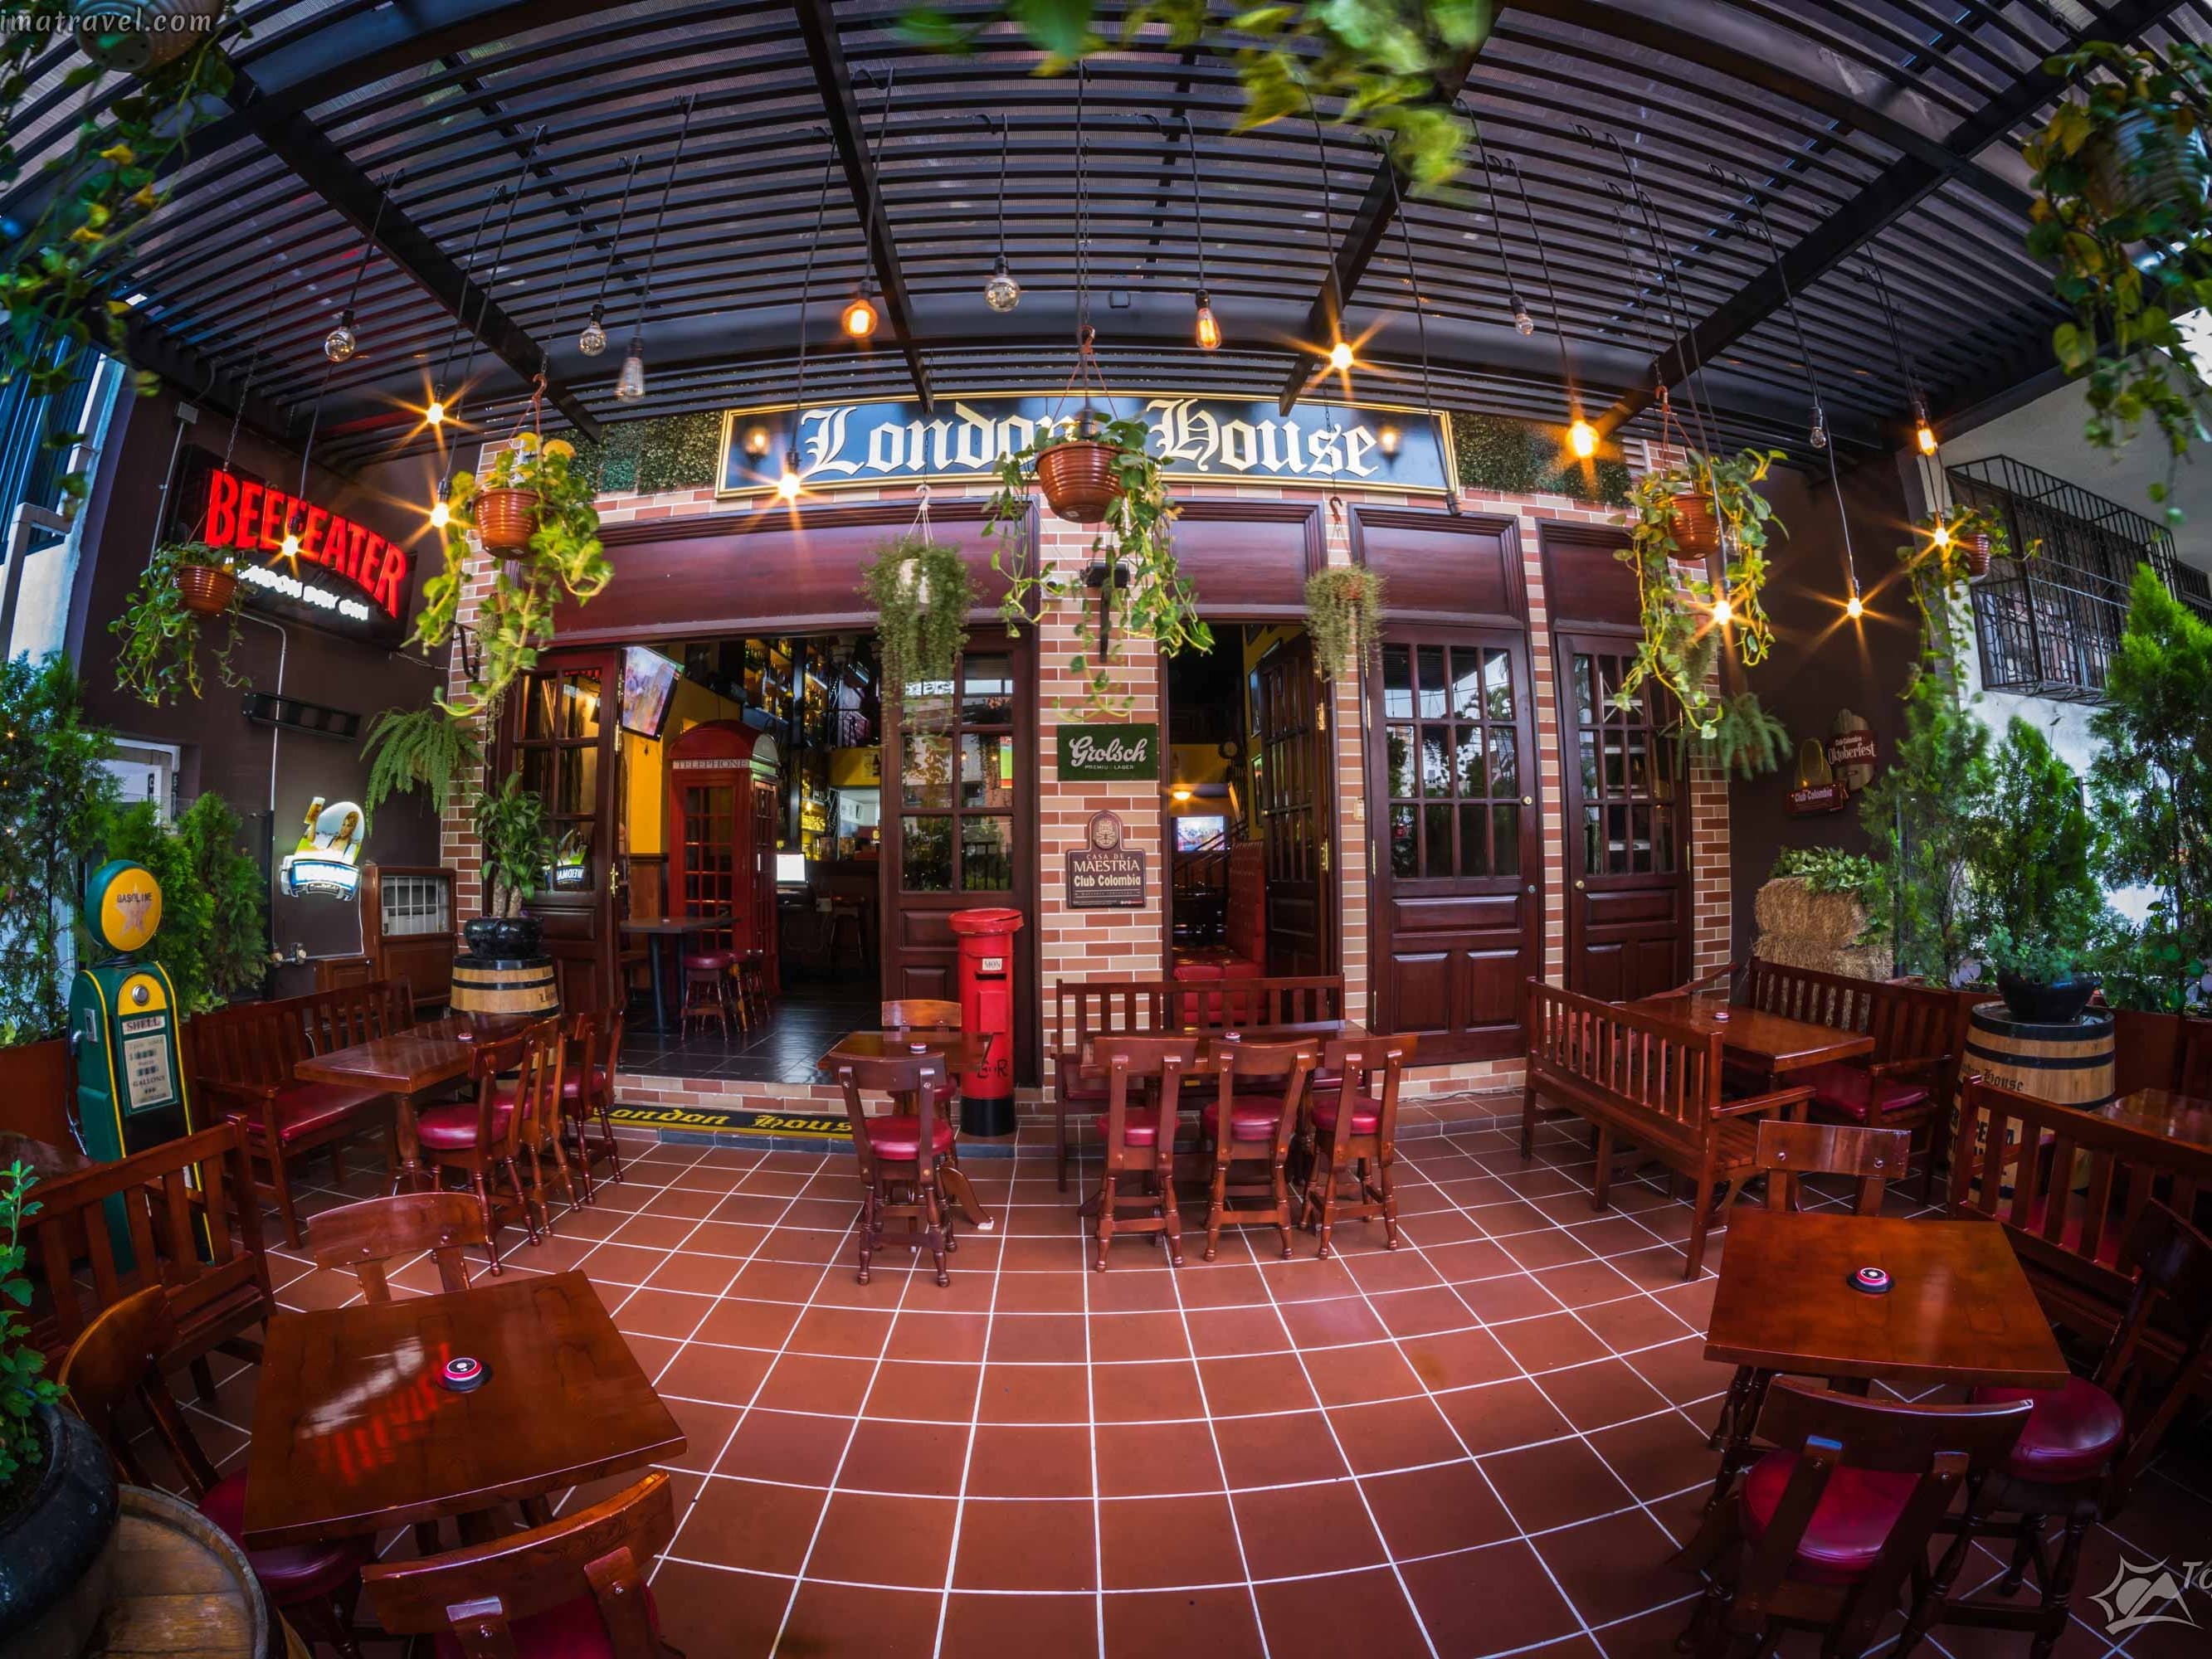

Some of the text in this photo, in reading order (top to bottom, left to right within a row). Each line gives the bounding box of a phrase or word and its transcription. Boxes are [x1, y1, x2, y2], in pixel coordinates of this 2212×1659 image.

[1146, 397, 1379, 479] House
[204, 468, 407, 619] BEEFEATER
[1069, 736, 1147, 767] Grolsch
[1828, 741, 1877, 765] Oktoberfest
[1073, 857, 1141, 873] MAESTRÍA
[1074, 873, 1142, 887] Club Colombia
[117, 892, 153, 903] GASOLINE
[126, 1017, 161, 1032] SHELL
[1985, 1068, 2024, 1092] House
[749, 1114, 854, 1131] Hous
